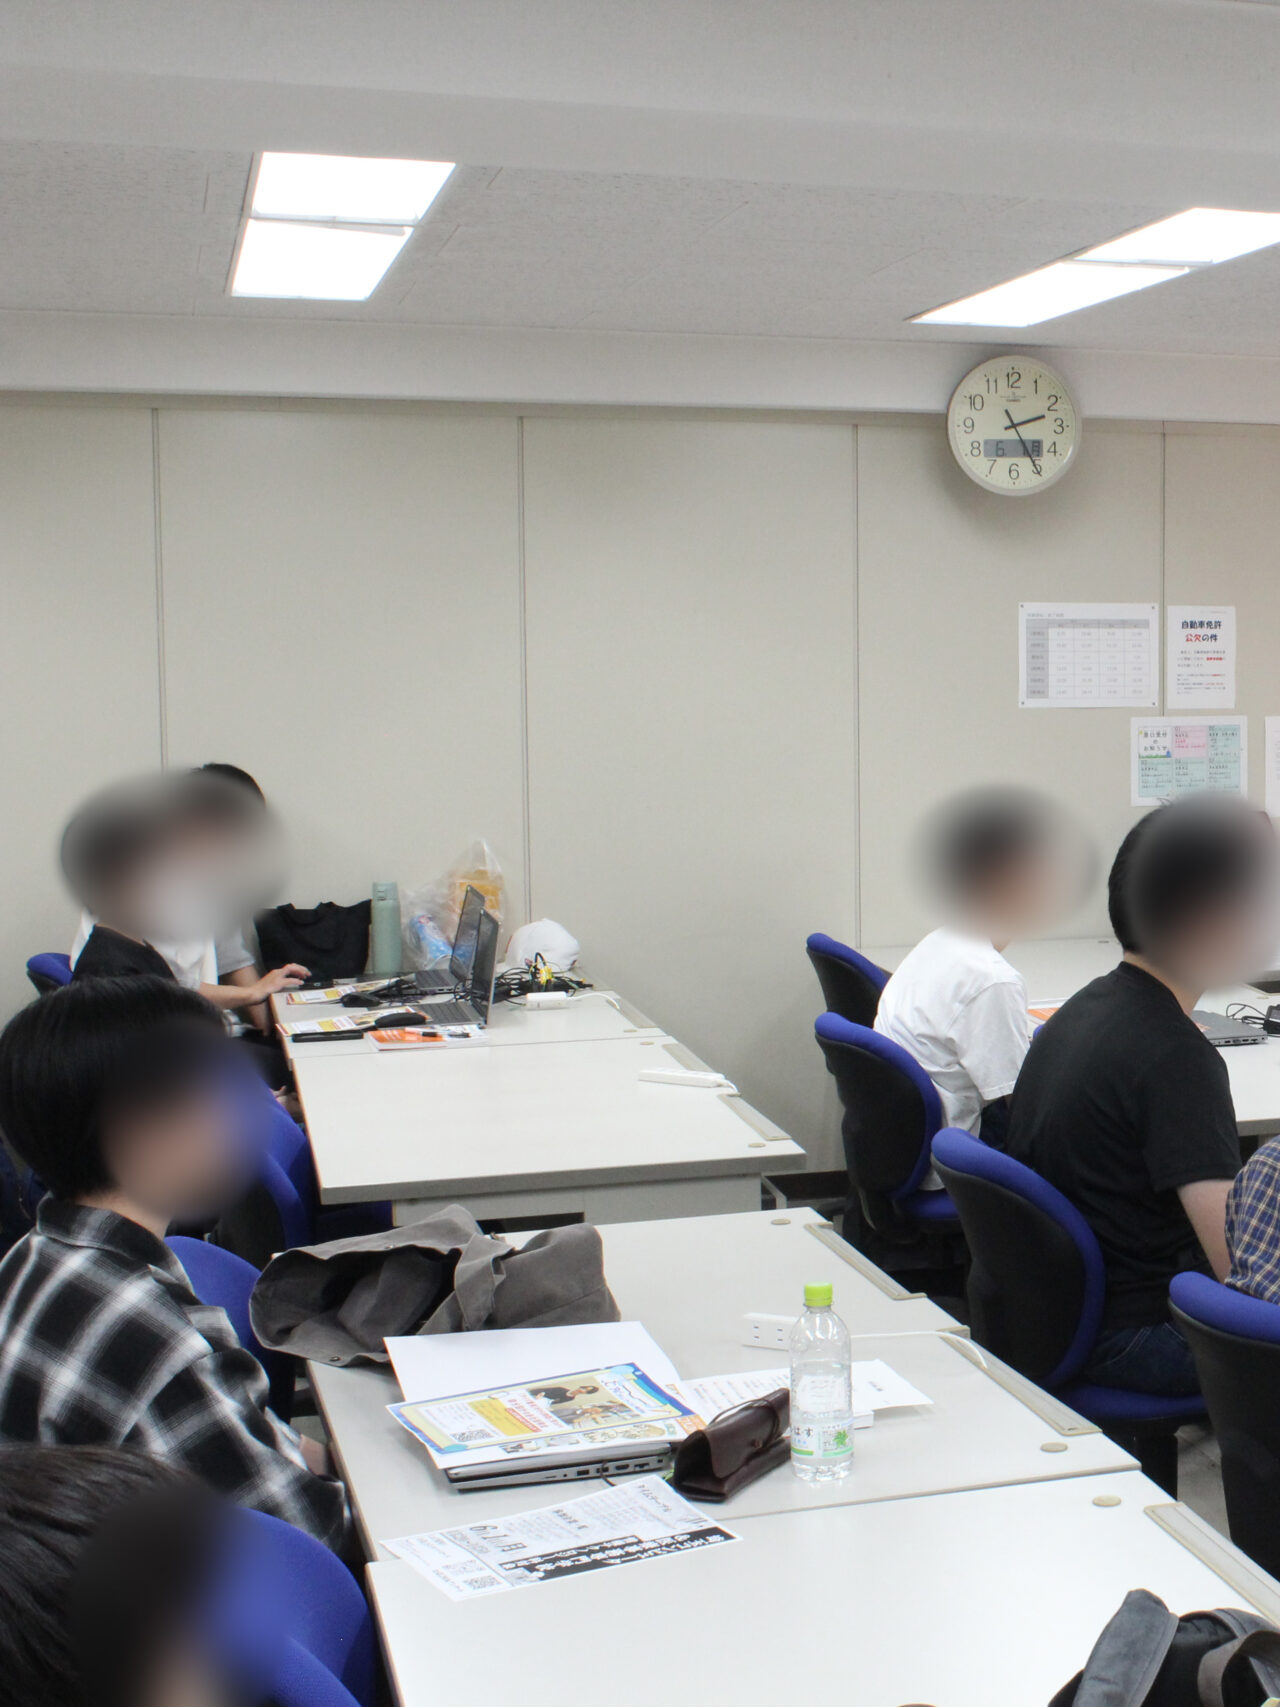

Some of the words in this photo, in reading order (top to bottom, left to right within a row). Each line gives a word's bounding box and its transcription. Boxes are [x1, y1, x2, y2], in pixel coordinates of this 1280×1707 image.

[985, 377, 998, 394] 11
[1006, 371, 1022, 389] 12
[1033, 378, 1038, 395] 1
[969, 394, 985, 411] 10
[1047, 394, 1059, 412] 2
[963, 417, 975, 434] 9
[1053, 417, 1065, 434] 3
[971, 440, 982, 457] 8
[1047, 441, 1058, 457] 4
[987, 459, 998, 475] 7
[1008, 463, 1020, 480] 6
[1181, 620, 1222, 630] 自動車免許
[1185, 633, 1218, 643] 公欠の件
